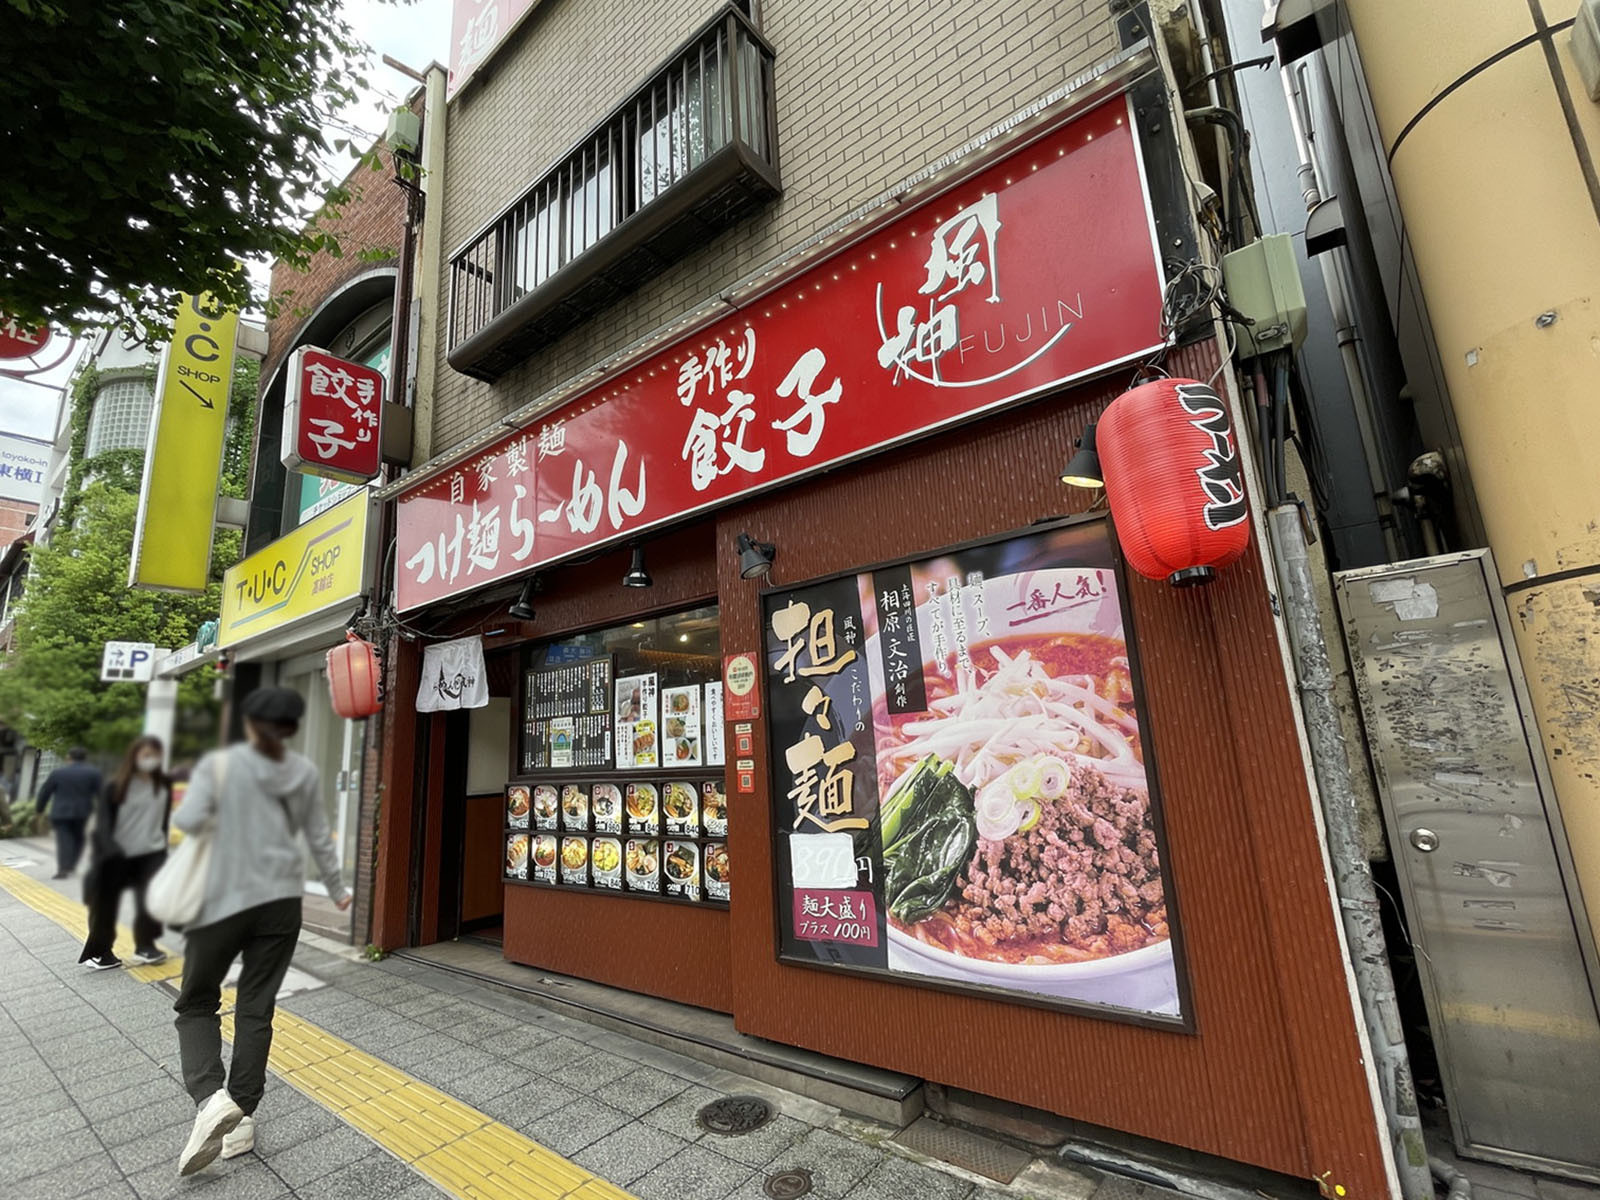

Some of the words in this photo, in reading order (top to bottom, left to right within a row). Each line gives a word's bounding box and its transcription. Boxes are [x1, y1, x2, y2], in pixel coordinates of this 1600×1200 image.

[958, 292, 1084, 364] FUJIN
[177, 365, 221, 383] SHOP
[677, 328, 757, 408] 手作り
[305, 362, 360, 460] 餃子
[352, 377, 379, 443] 手作り
[682, 347, 844, 492] 餃子
[450, 423, 567, 505] 自家製麺
[311, 545, 341, 576] SHOP
[130, 650, 149, 668] P
[843, 616, 857, 645] 風神
[851, 668, 866, 732] こだわりの
[800, 921, 829, 935] プラス
[834, 922, 871, 940] 100円
[802, 894, 867, 921] 麺大盛り
